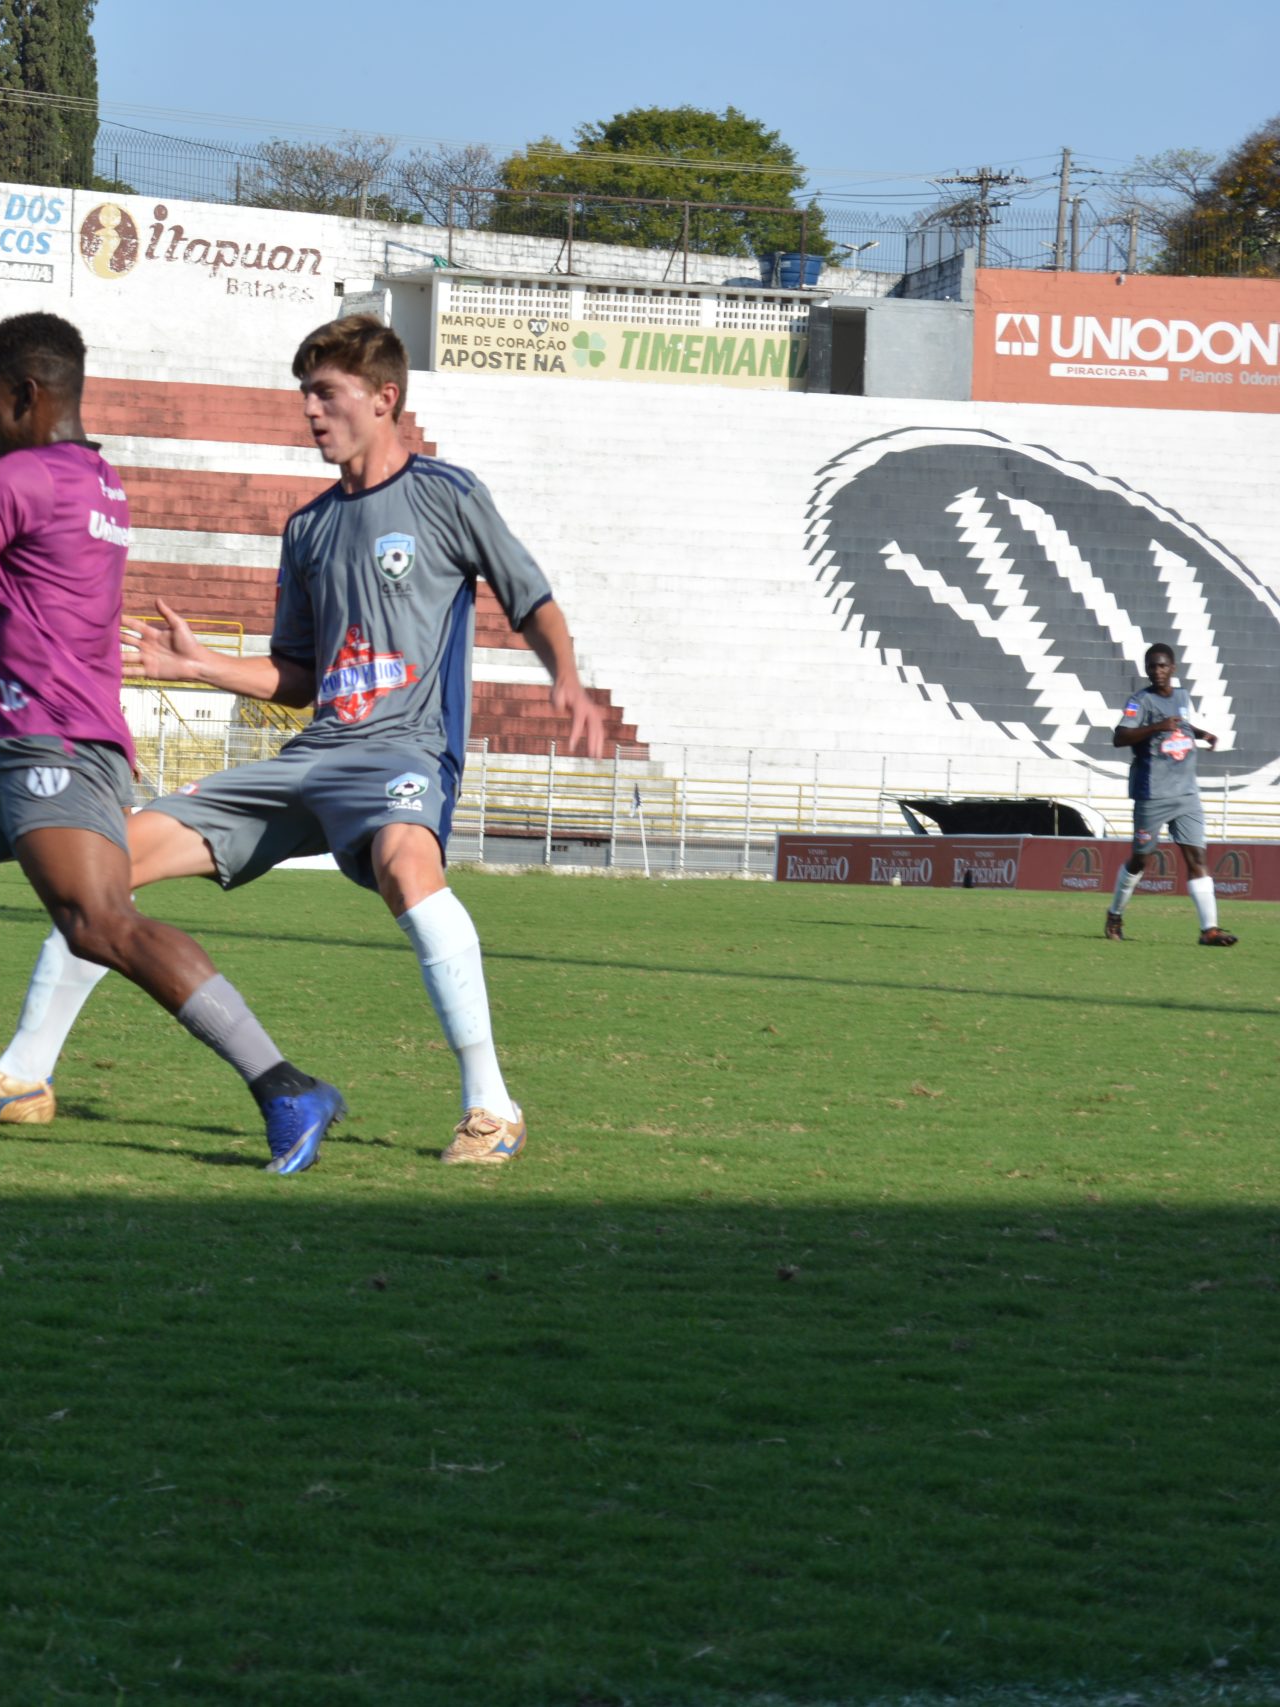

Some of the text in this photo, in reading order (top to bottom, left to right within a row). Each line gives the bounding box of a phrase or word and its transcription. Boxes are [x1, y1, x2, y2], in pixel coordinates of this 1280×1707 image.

[4, 193, 65, 225] DOS
[145, 204, 322, 278] itapuan
[441, 314, 570, 333] MARQUE O XV NO
[440, 333, 567, 352] TIME DE CORAÇÃO
[1051, 314, 1280, 366] UNIODON
[440, 348, 567, 374] APOSTE NA
[1066, 366, 1148, 378] PIRACICABA
[1179, 367, 1233, 385] Planos
[786, 855, 849, 881] EXPEDITO
[1062, 877, 1099, 889] MIRANTE
